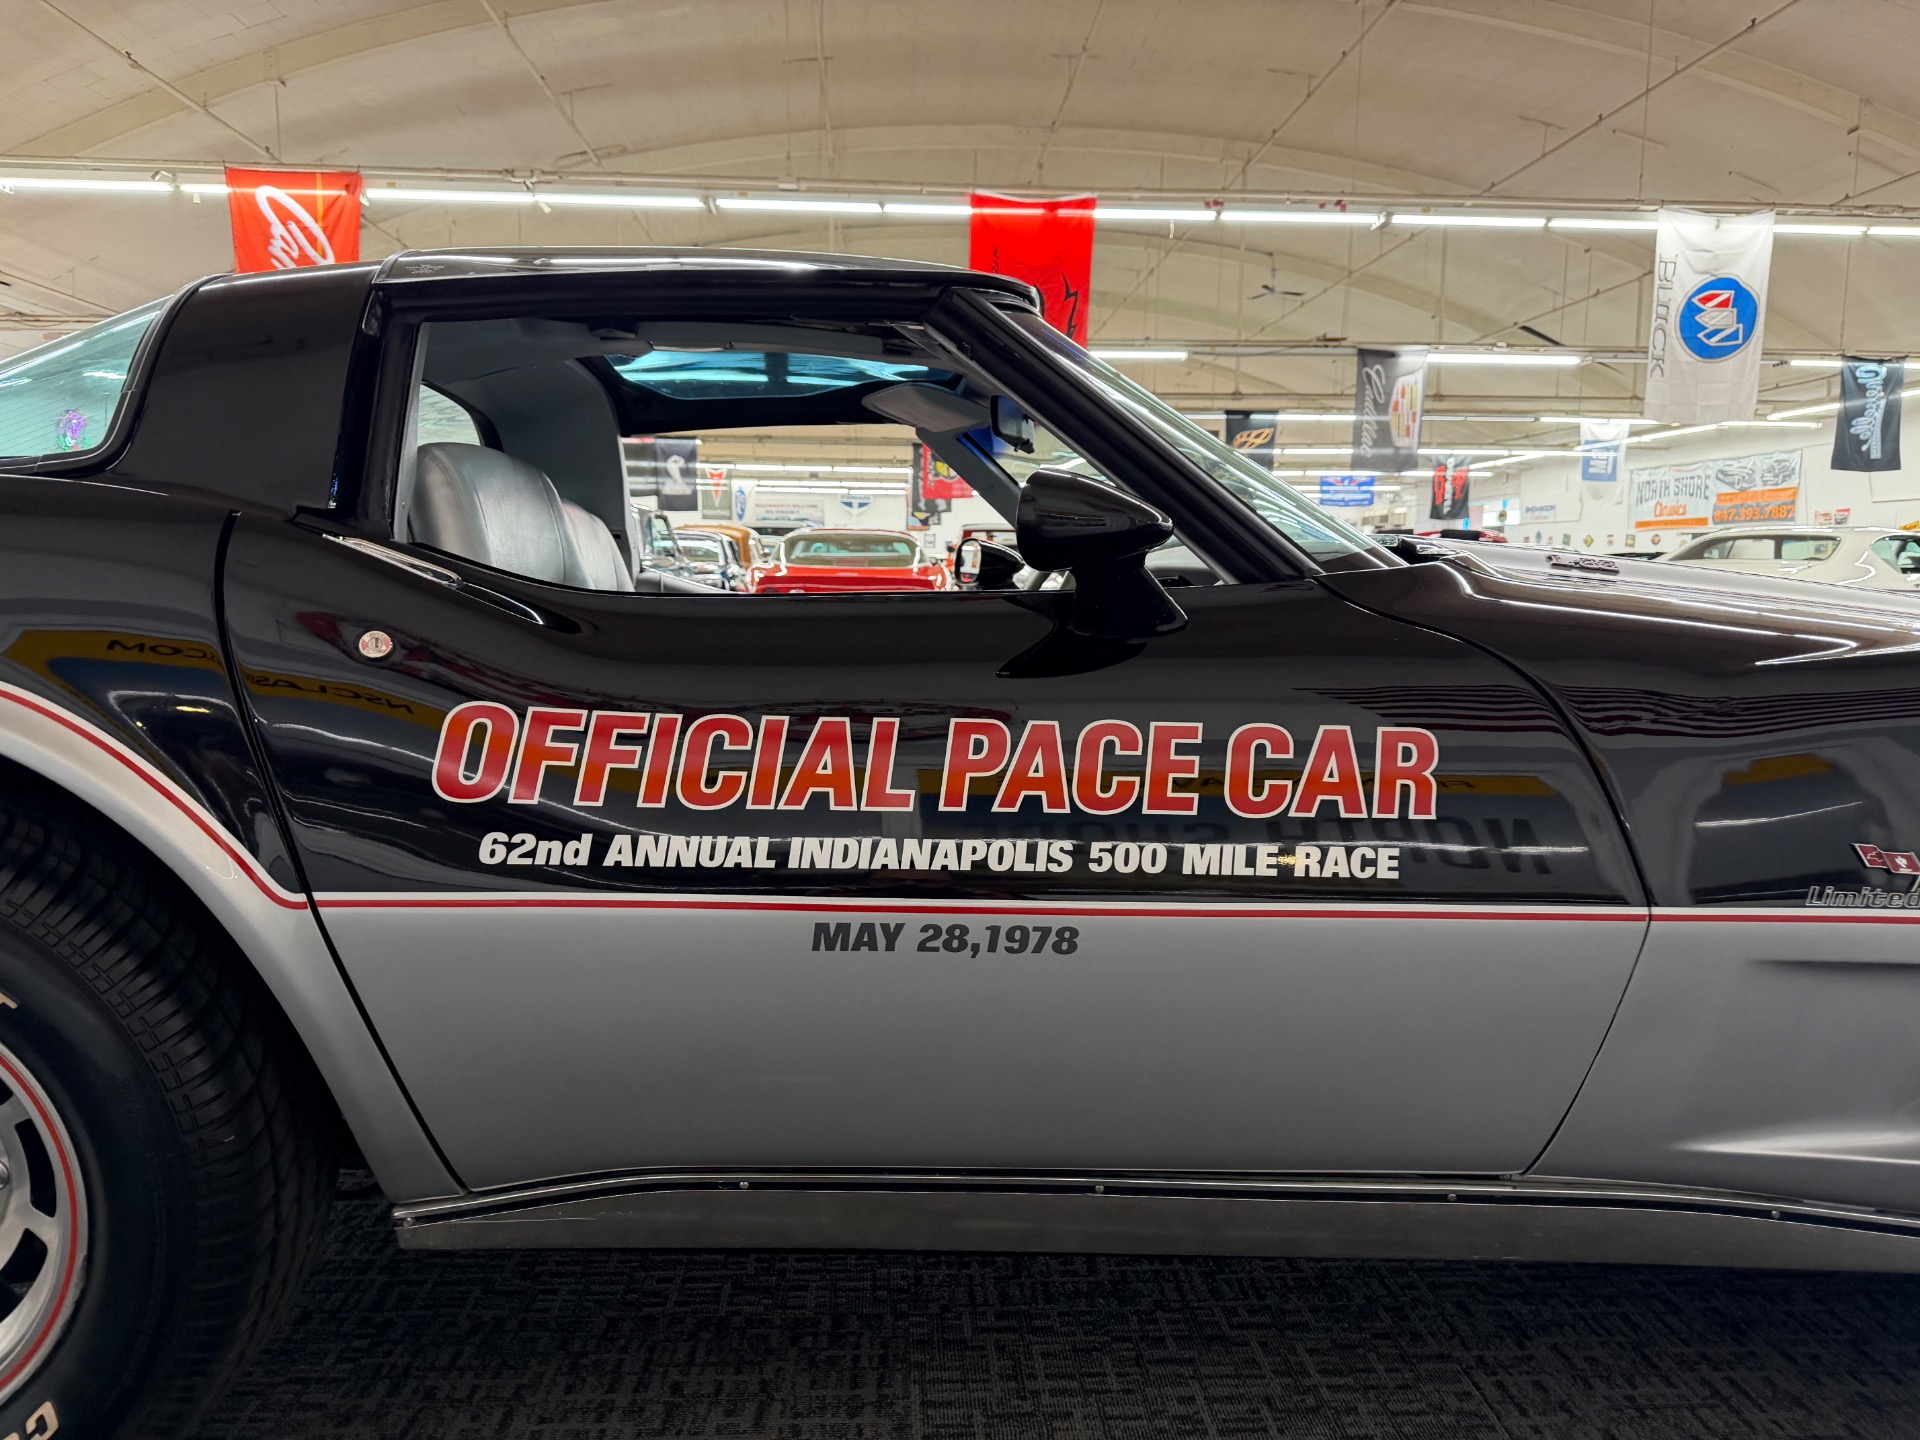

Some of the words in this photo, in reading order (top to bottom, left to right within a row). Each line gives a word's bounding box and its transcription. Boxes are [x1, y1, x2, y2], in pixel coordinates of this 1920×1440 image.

[1650, 253, 1678, 378] BUICK
[1360, 364, 1386, 458] Cadillac
[1636, 478, 1670, 506] NORTH
[1674, 473, 1711, 501] SHORE
[431, 700, 915, 811] OFFICIAL
[938, 717, 1203, 815] PACE
[1224, 722, 1439, 819] CAR
[479, 832, 593, 866] 62nd
[602, 833, 776, 869] ANNUAL
[787, 836, 1073, 874] INDIANAPOLIS
[1088, 841, 1168, 875] 500
[1182, 843, 1278, 877] MILE
[1293, 845, 1400, 880] RACE
[1805, 885, 1920, 908] Limited
[811, 922, 907, 952] MAY
[916, 923, 1080, 958] 28,1978
